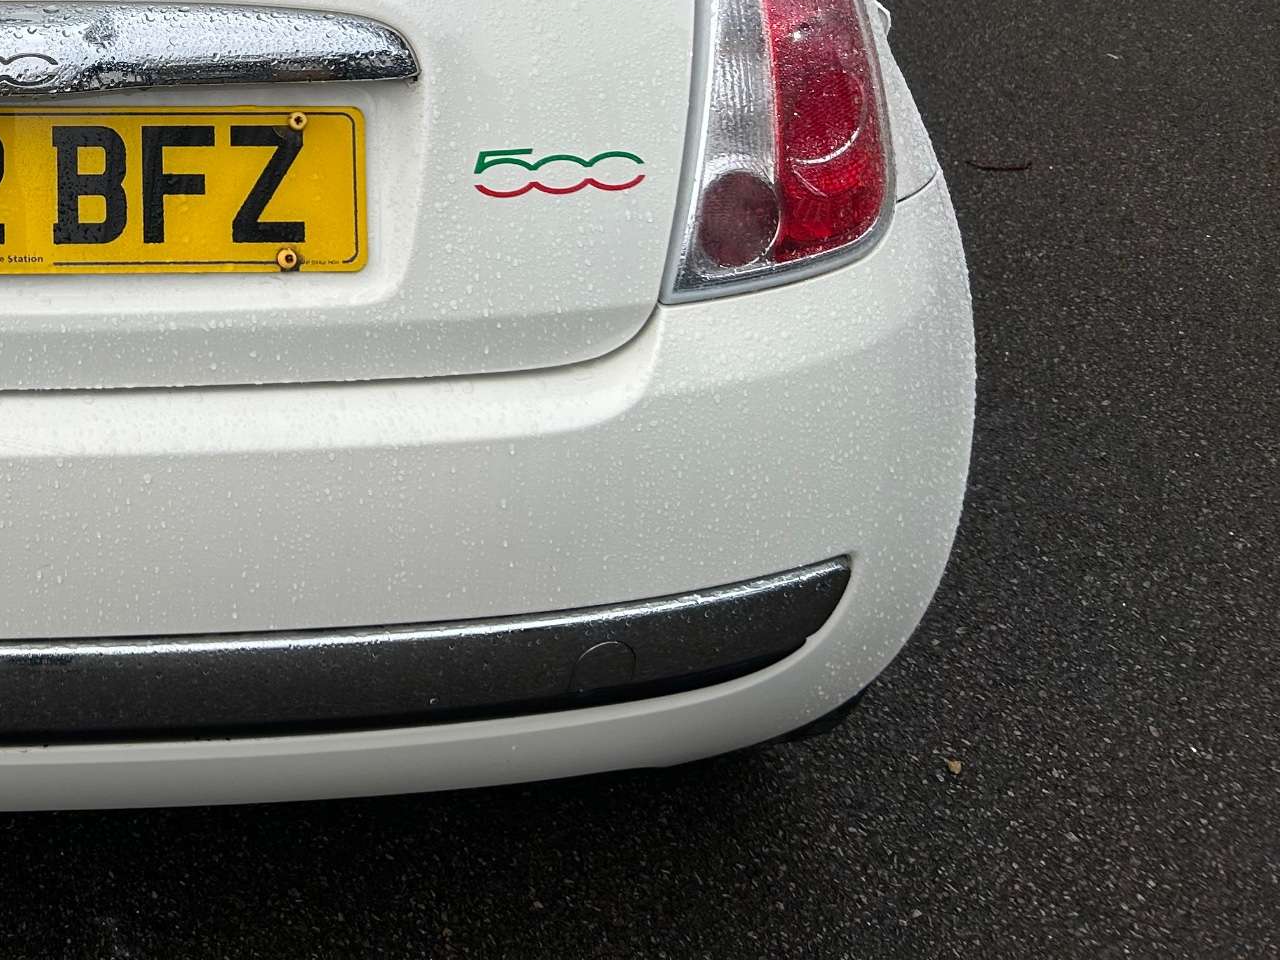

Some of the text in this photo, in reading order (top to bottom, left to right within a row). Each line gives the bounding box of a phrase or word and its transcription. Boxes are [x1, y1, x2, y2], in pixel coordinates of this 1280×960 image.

[53, 125, 306, 247] BFZ
[473, 147, 646, 199] 500
[7, 254, 44, 264] Station
